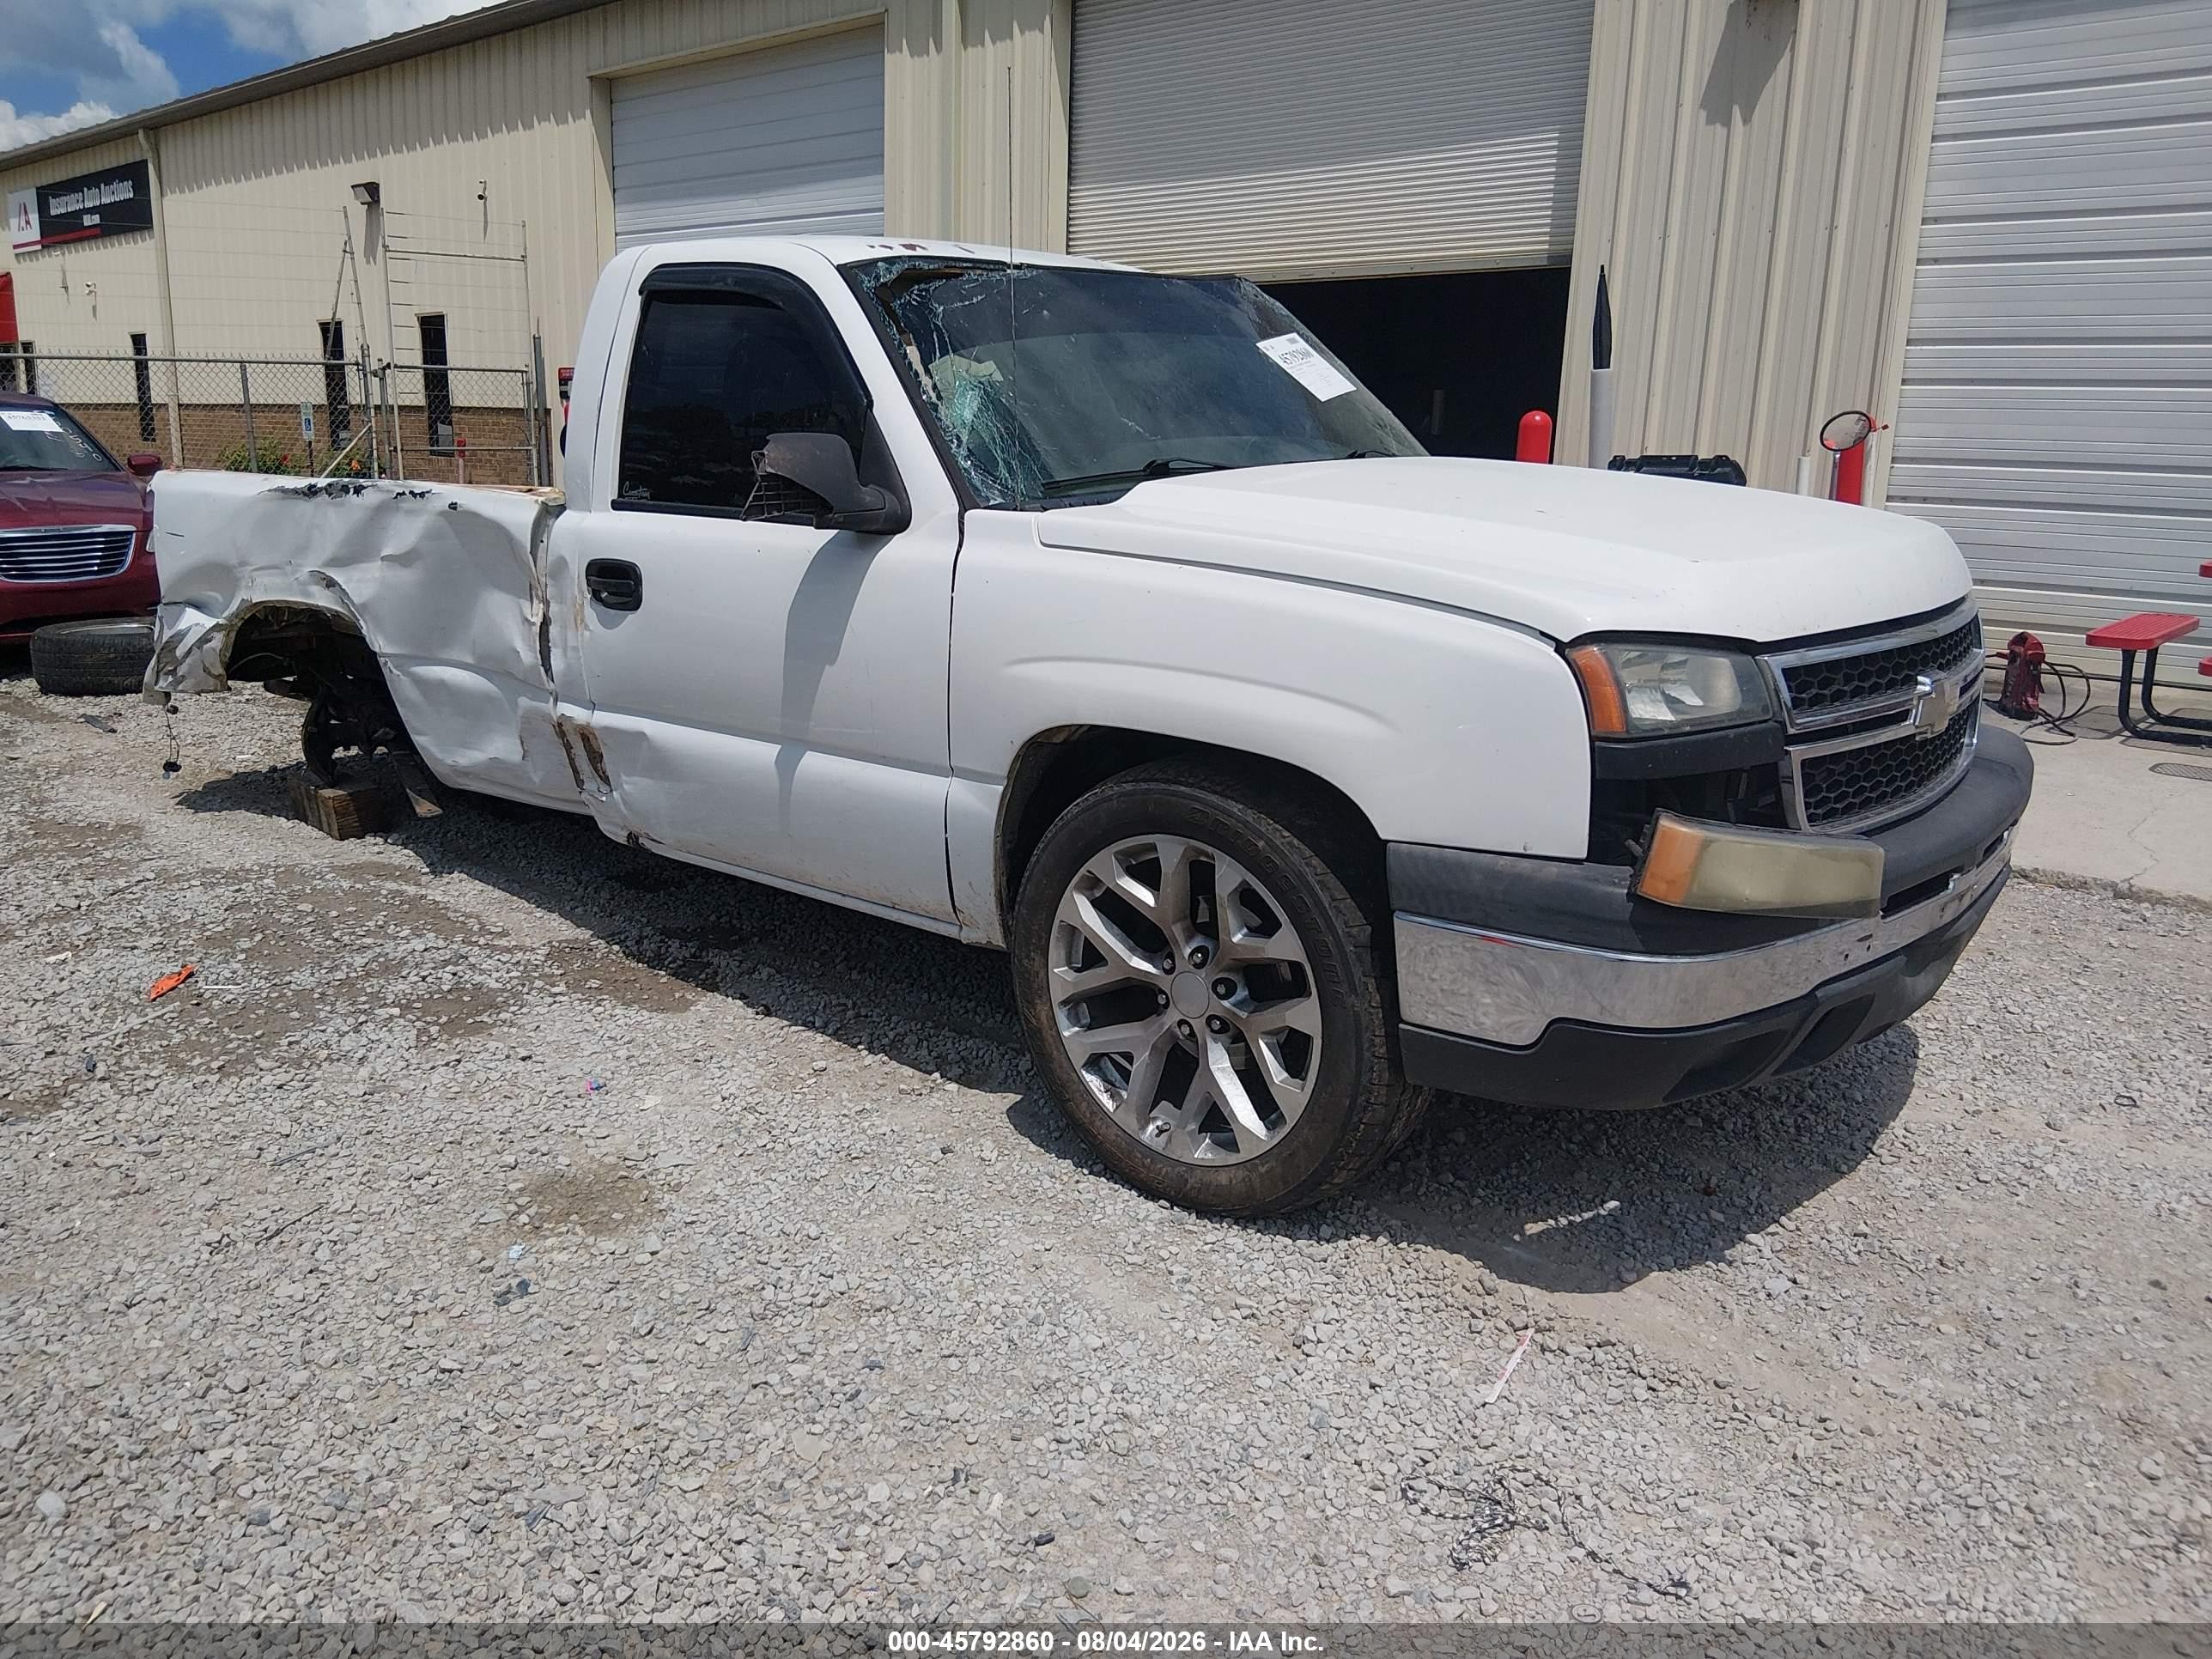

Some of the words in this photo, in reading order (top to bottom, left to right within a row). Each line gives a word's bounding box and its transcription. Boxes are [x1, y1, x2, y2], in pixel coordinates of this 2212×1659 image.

[49, 191, 84, 216] Insurance
[84, 187, 100, 209] Auto
[100, 179, 134, 205] Auctions
[1187, 805, 1346, 1010] BRIDGESTONE
